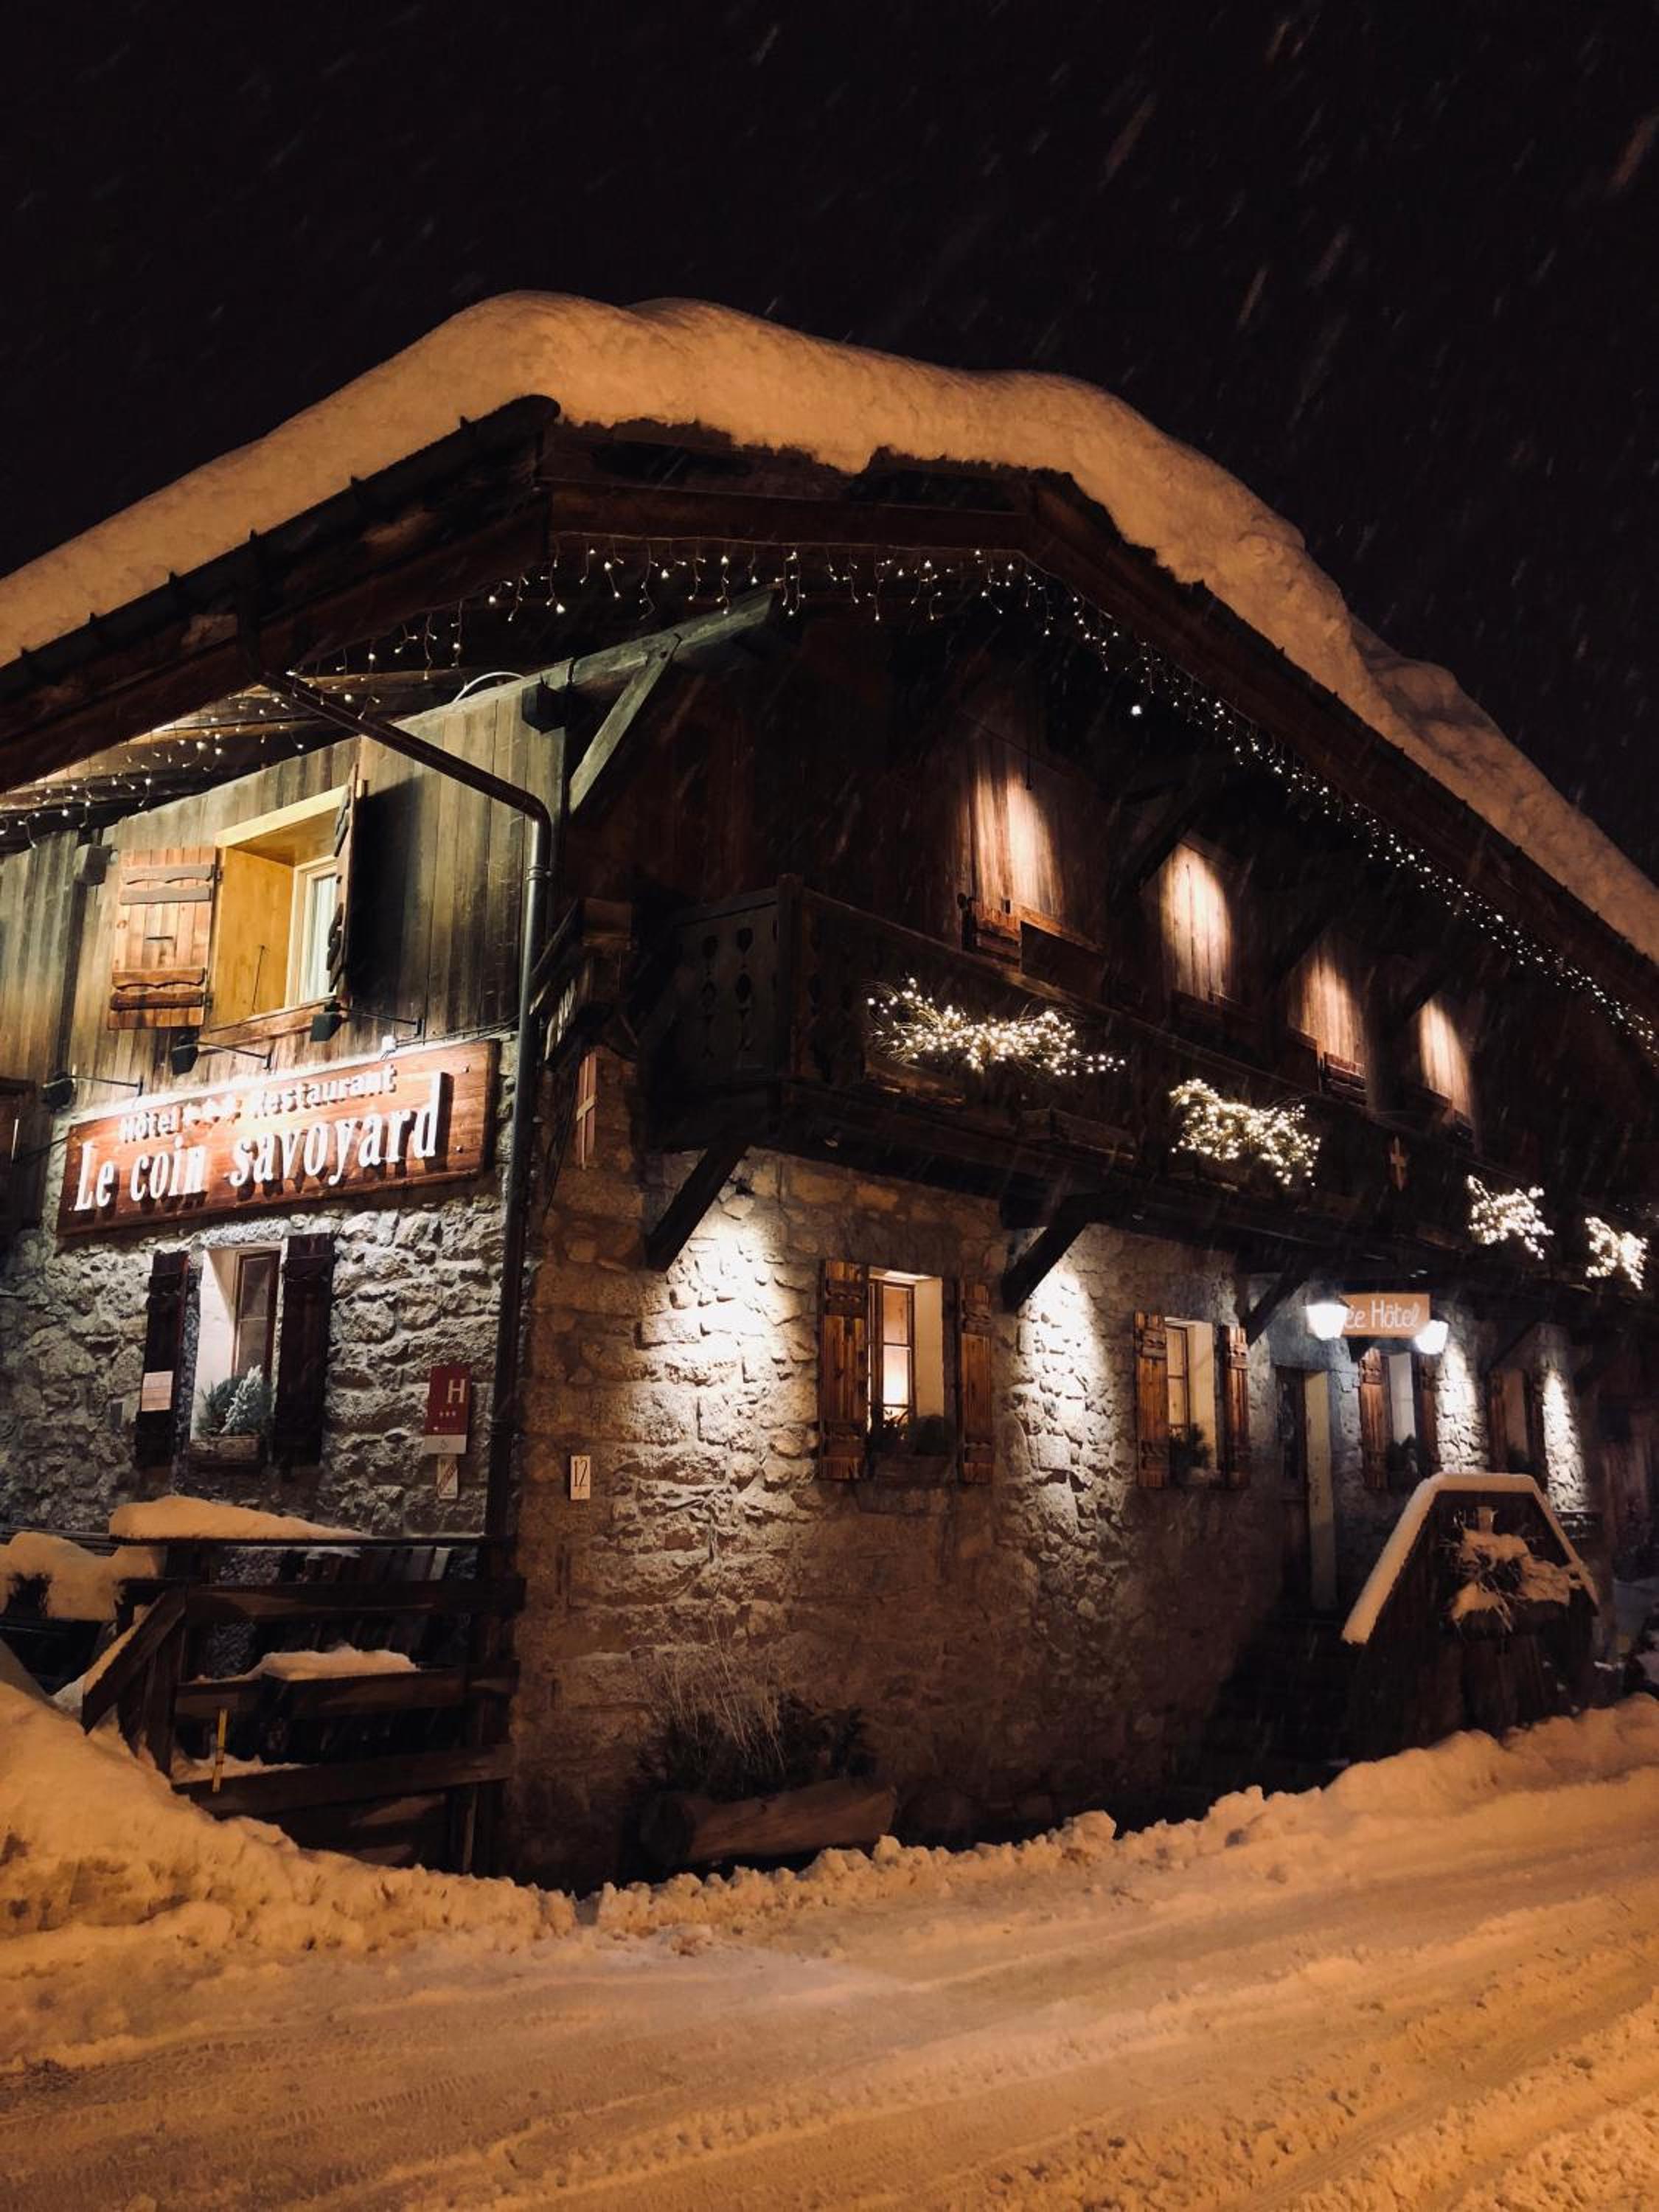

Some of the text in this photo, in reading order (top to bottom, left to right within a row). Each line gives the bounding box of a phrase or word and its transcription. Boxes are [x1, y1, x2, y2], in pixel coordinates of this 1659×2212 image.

[251, 1064, 397, 1116] Restaurant
[73, 1071, 443, 1211] Le coin savoyard
[1371, 1298, 1420, 1329] Hôtel
[448, 1379, 466, 1403] H
